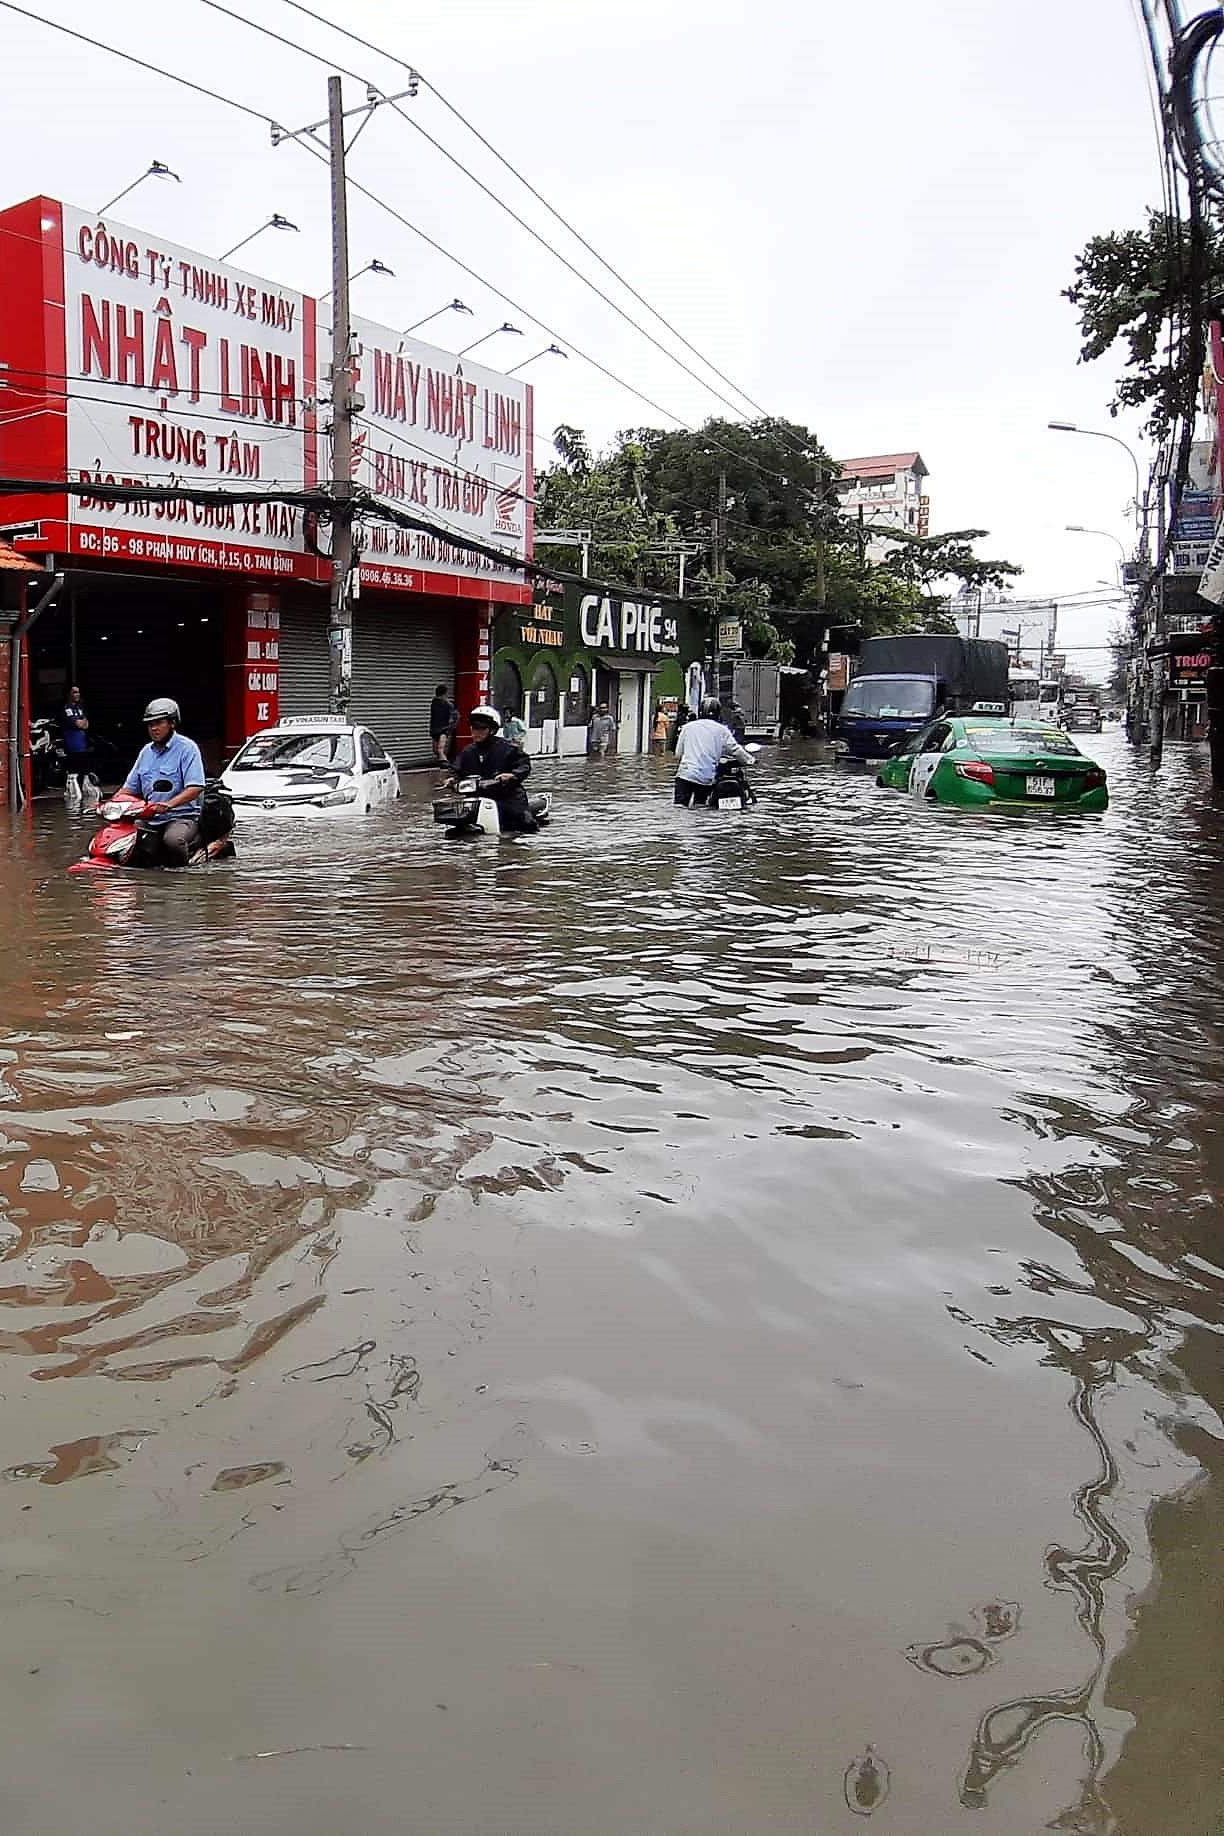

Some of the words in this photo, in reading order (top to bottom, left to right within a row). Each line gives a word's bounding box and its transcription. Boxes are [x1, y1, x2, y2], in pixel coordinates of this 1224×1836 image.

[79, 221, 139, 280] CÔNG
[179, 261, 228, 311] TNHH
[233, 281, 257, 320] XE
[261, 290, 295, 333] MÁY
[80, 292, 208, 412] NHẬT
[218, 337, 296, 427] LINH
[373, 341, 421, 427] MÁY
[425, 362, 477, 452] NHẬT
[482, 388, 521, 458] LINH
[128, 415, 207, 469] TRUNG
[215, 429, 261, 479] TÂM
[409, 459, 429, 506] XE
[239, 500, 262, 536] XE
[494, 518, 522, 534] HONDA
[79, 533, 101, 550] ĐC:
[103, 535, 119, 553] 96
[129, 538, 144, 555] 98
[146, 540, 174, 560] PHAN
[176, 544, 197, 562] HUY
[248, 668, 261, 691] CÁC
[257, 702, 270, 721] XE
